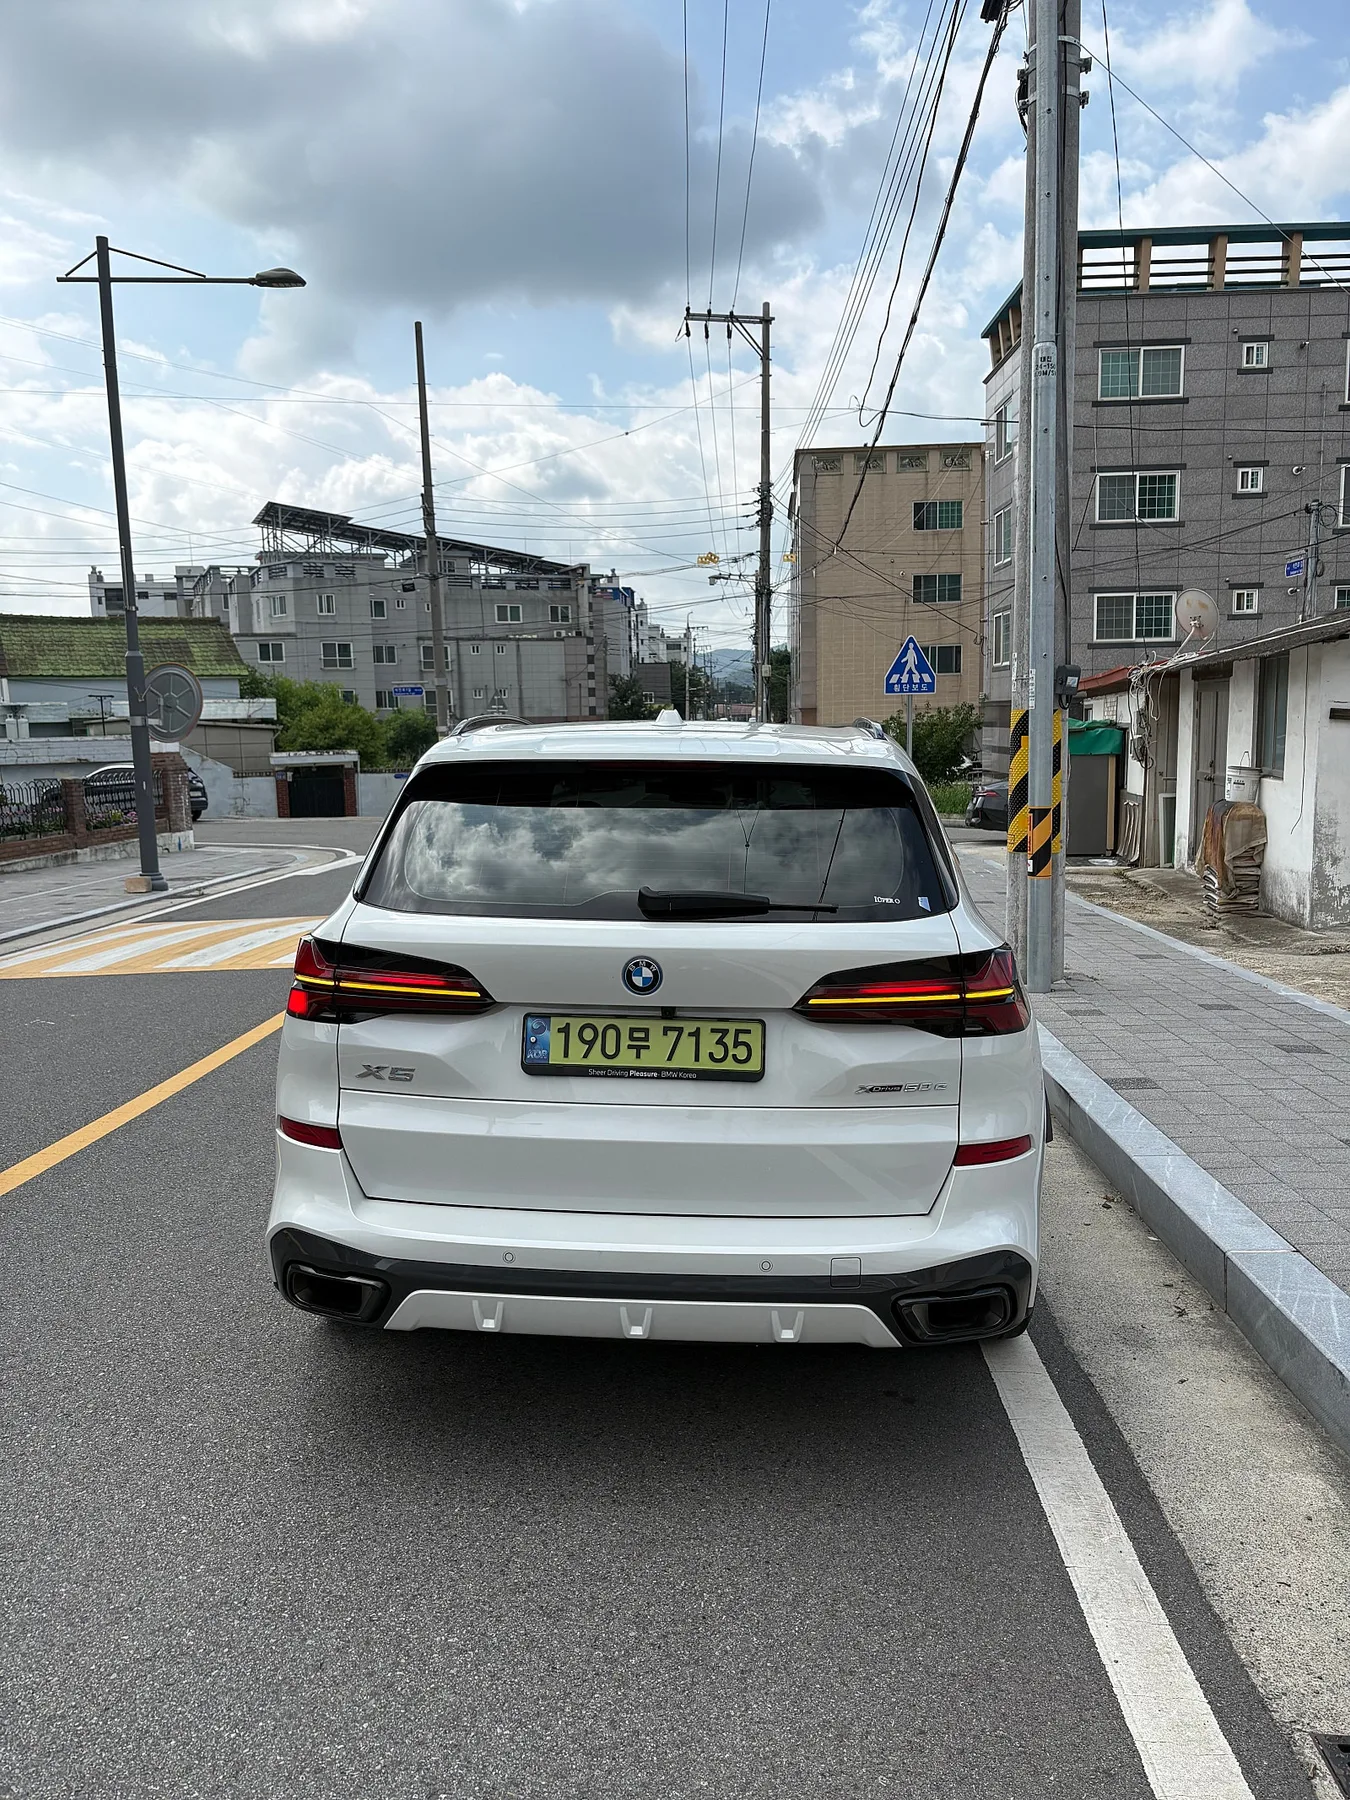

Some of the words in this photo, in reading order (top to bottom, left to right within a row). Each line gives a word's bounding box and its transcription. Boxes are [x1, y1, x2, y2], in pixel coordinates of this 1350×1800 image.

[893, 684, 928, 692] 횡단보도
[557, 1022, 651, 1060] 190무
[662, 1026, 752, 1064] 7135
[355, 1064, 416, 1082] X5
[588, 1068, 606, 1076] Sheer
[607, 1069, 628, 1077] Driving
[629, 1070, 658, 1078] Pleasure
[661, 1070, 679, 1078] BMW
[679, 1071, 697, 1079] Korea
